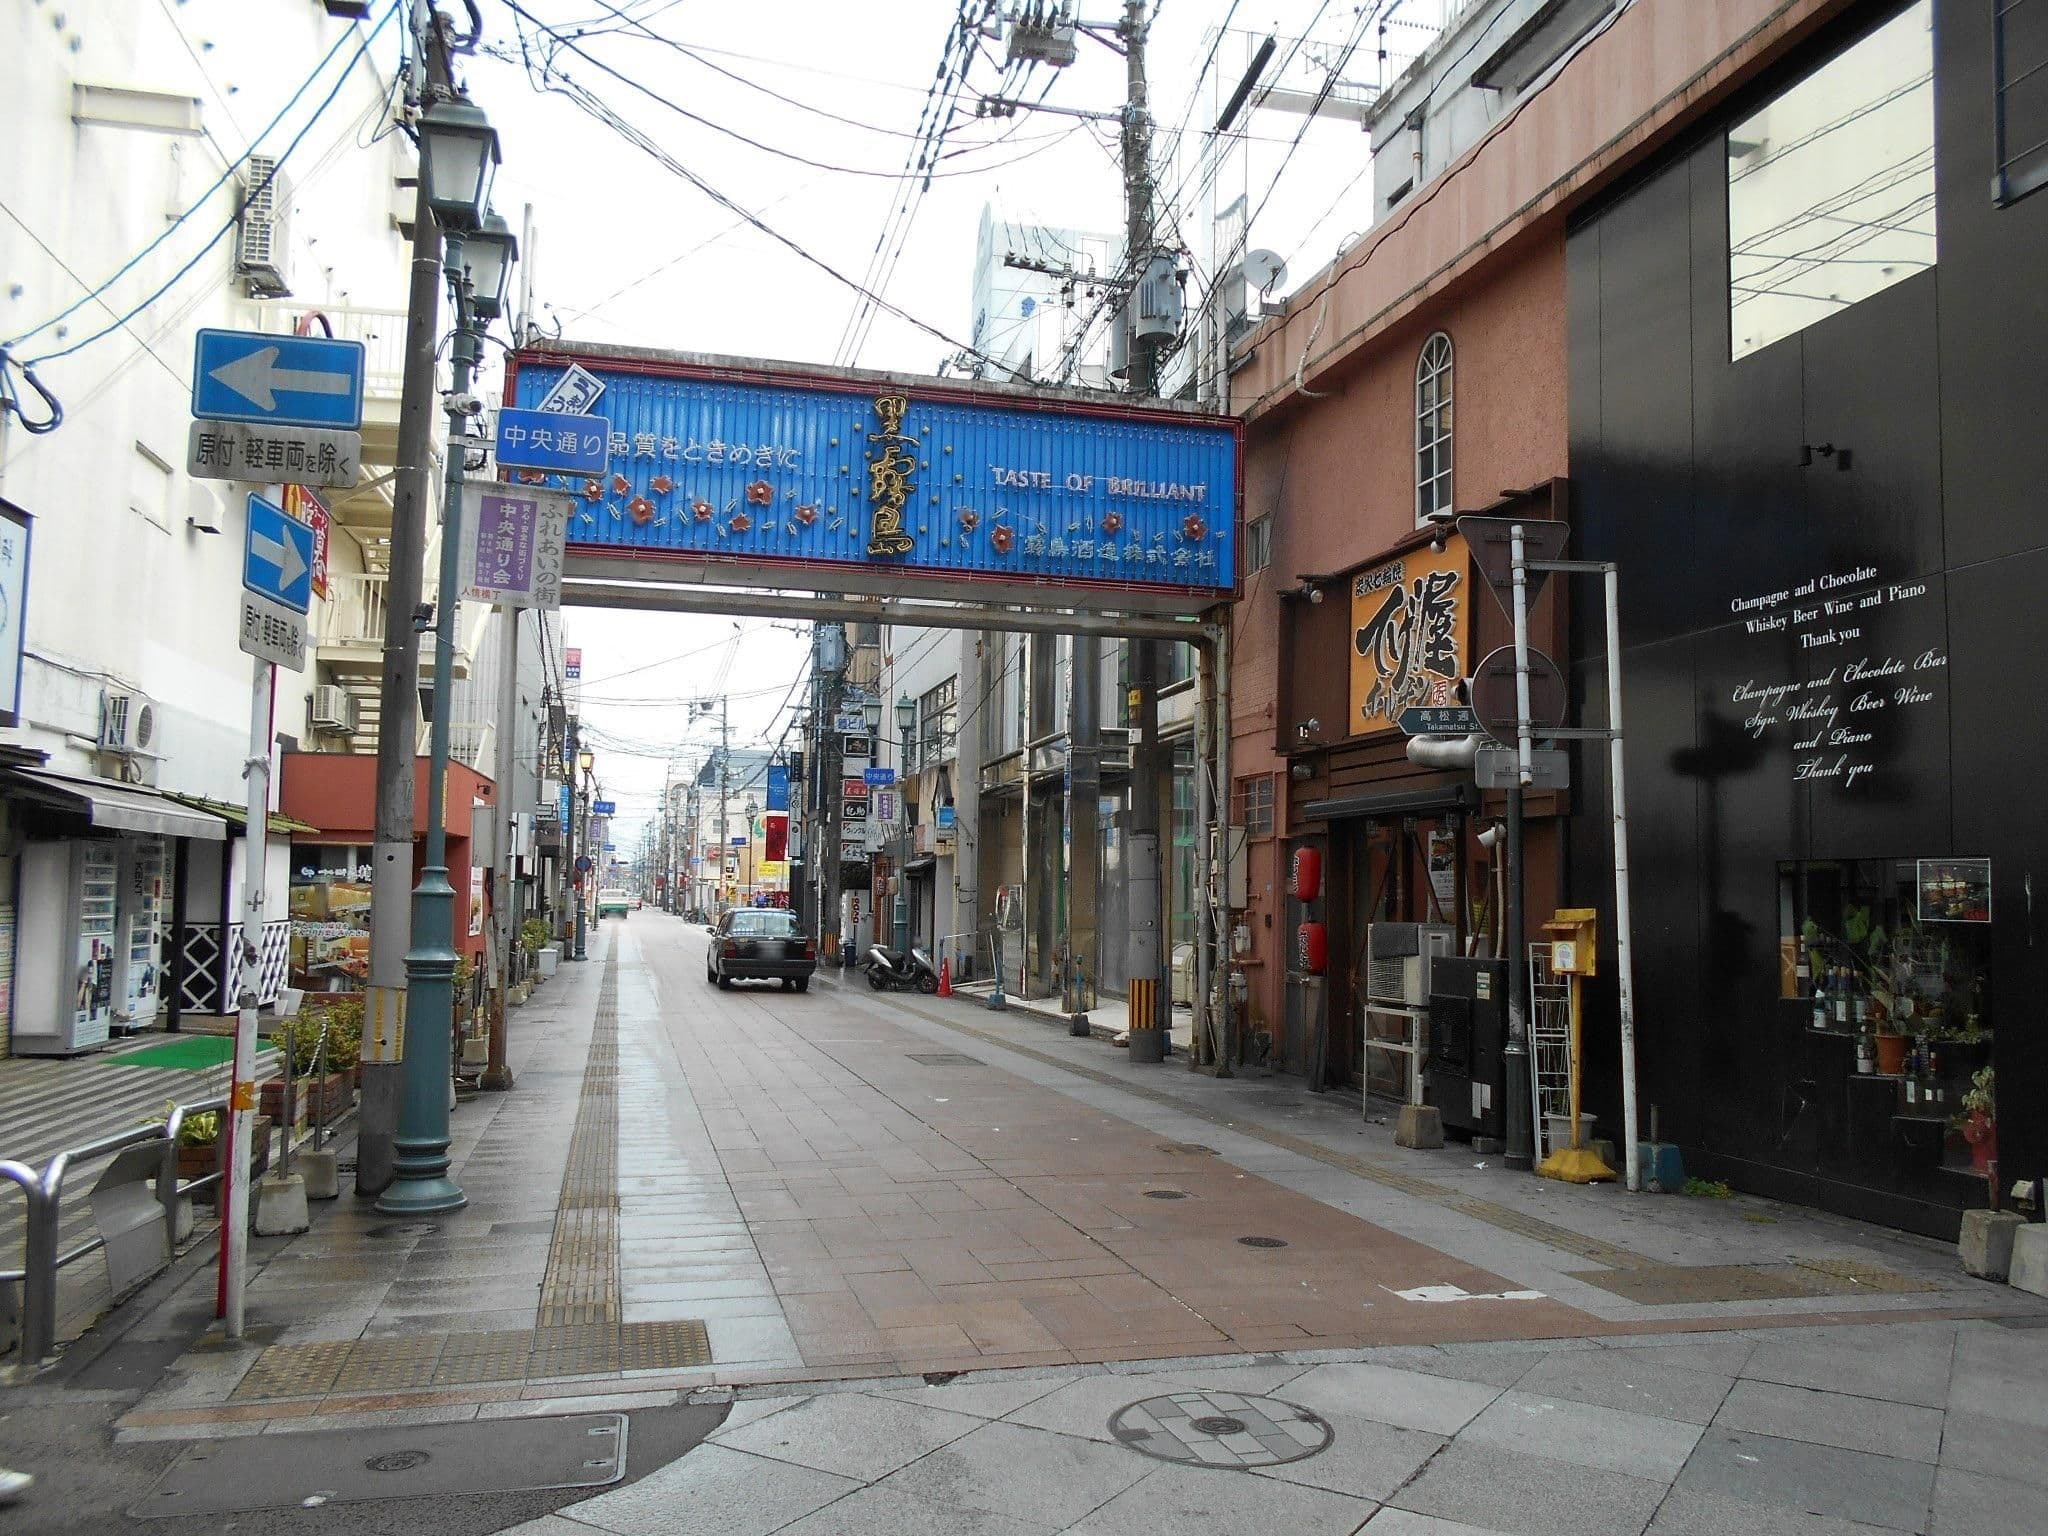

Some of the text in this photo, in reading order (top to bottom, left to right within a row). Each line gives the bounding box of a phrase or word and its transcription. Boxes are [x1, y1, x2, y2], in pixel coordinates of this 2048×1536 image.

[504, 424, 602, 456] 中央通り
[609, 431, 801, 468] 品質をときめきに
[991, 467, 1207, 502] TASTE OF BRILLIANT
[493, 503, 517, 584] 中央通り会
[533, 503, 563, 603] ふれあいの街
[1024, 534, 1216, 568] 霧島酒造株式会社
[1731, 566, 1877, 612] Champagne and Chocolate
[1746, 584, 1926, 634] Whiskey Beer Wine and Piano
[1800, 627, 1861, 648] Thank you
[1733, 648, 1948, 707] Champagne and Chocolate Bar
[1786, 695, 1839, 728] Whiskey
[1850, 690, 1885, 713] Beer
[1894, 684, 1933, 705] Wine
[1426, 722, 1466, 731] Takamatsu
[1793, 726, 1873, 750] and Piano
[1793, 754, 1874, 787] Thank you
[135, 862, 144, 896] KENT
